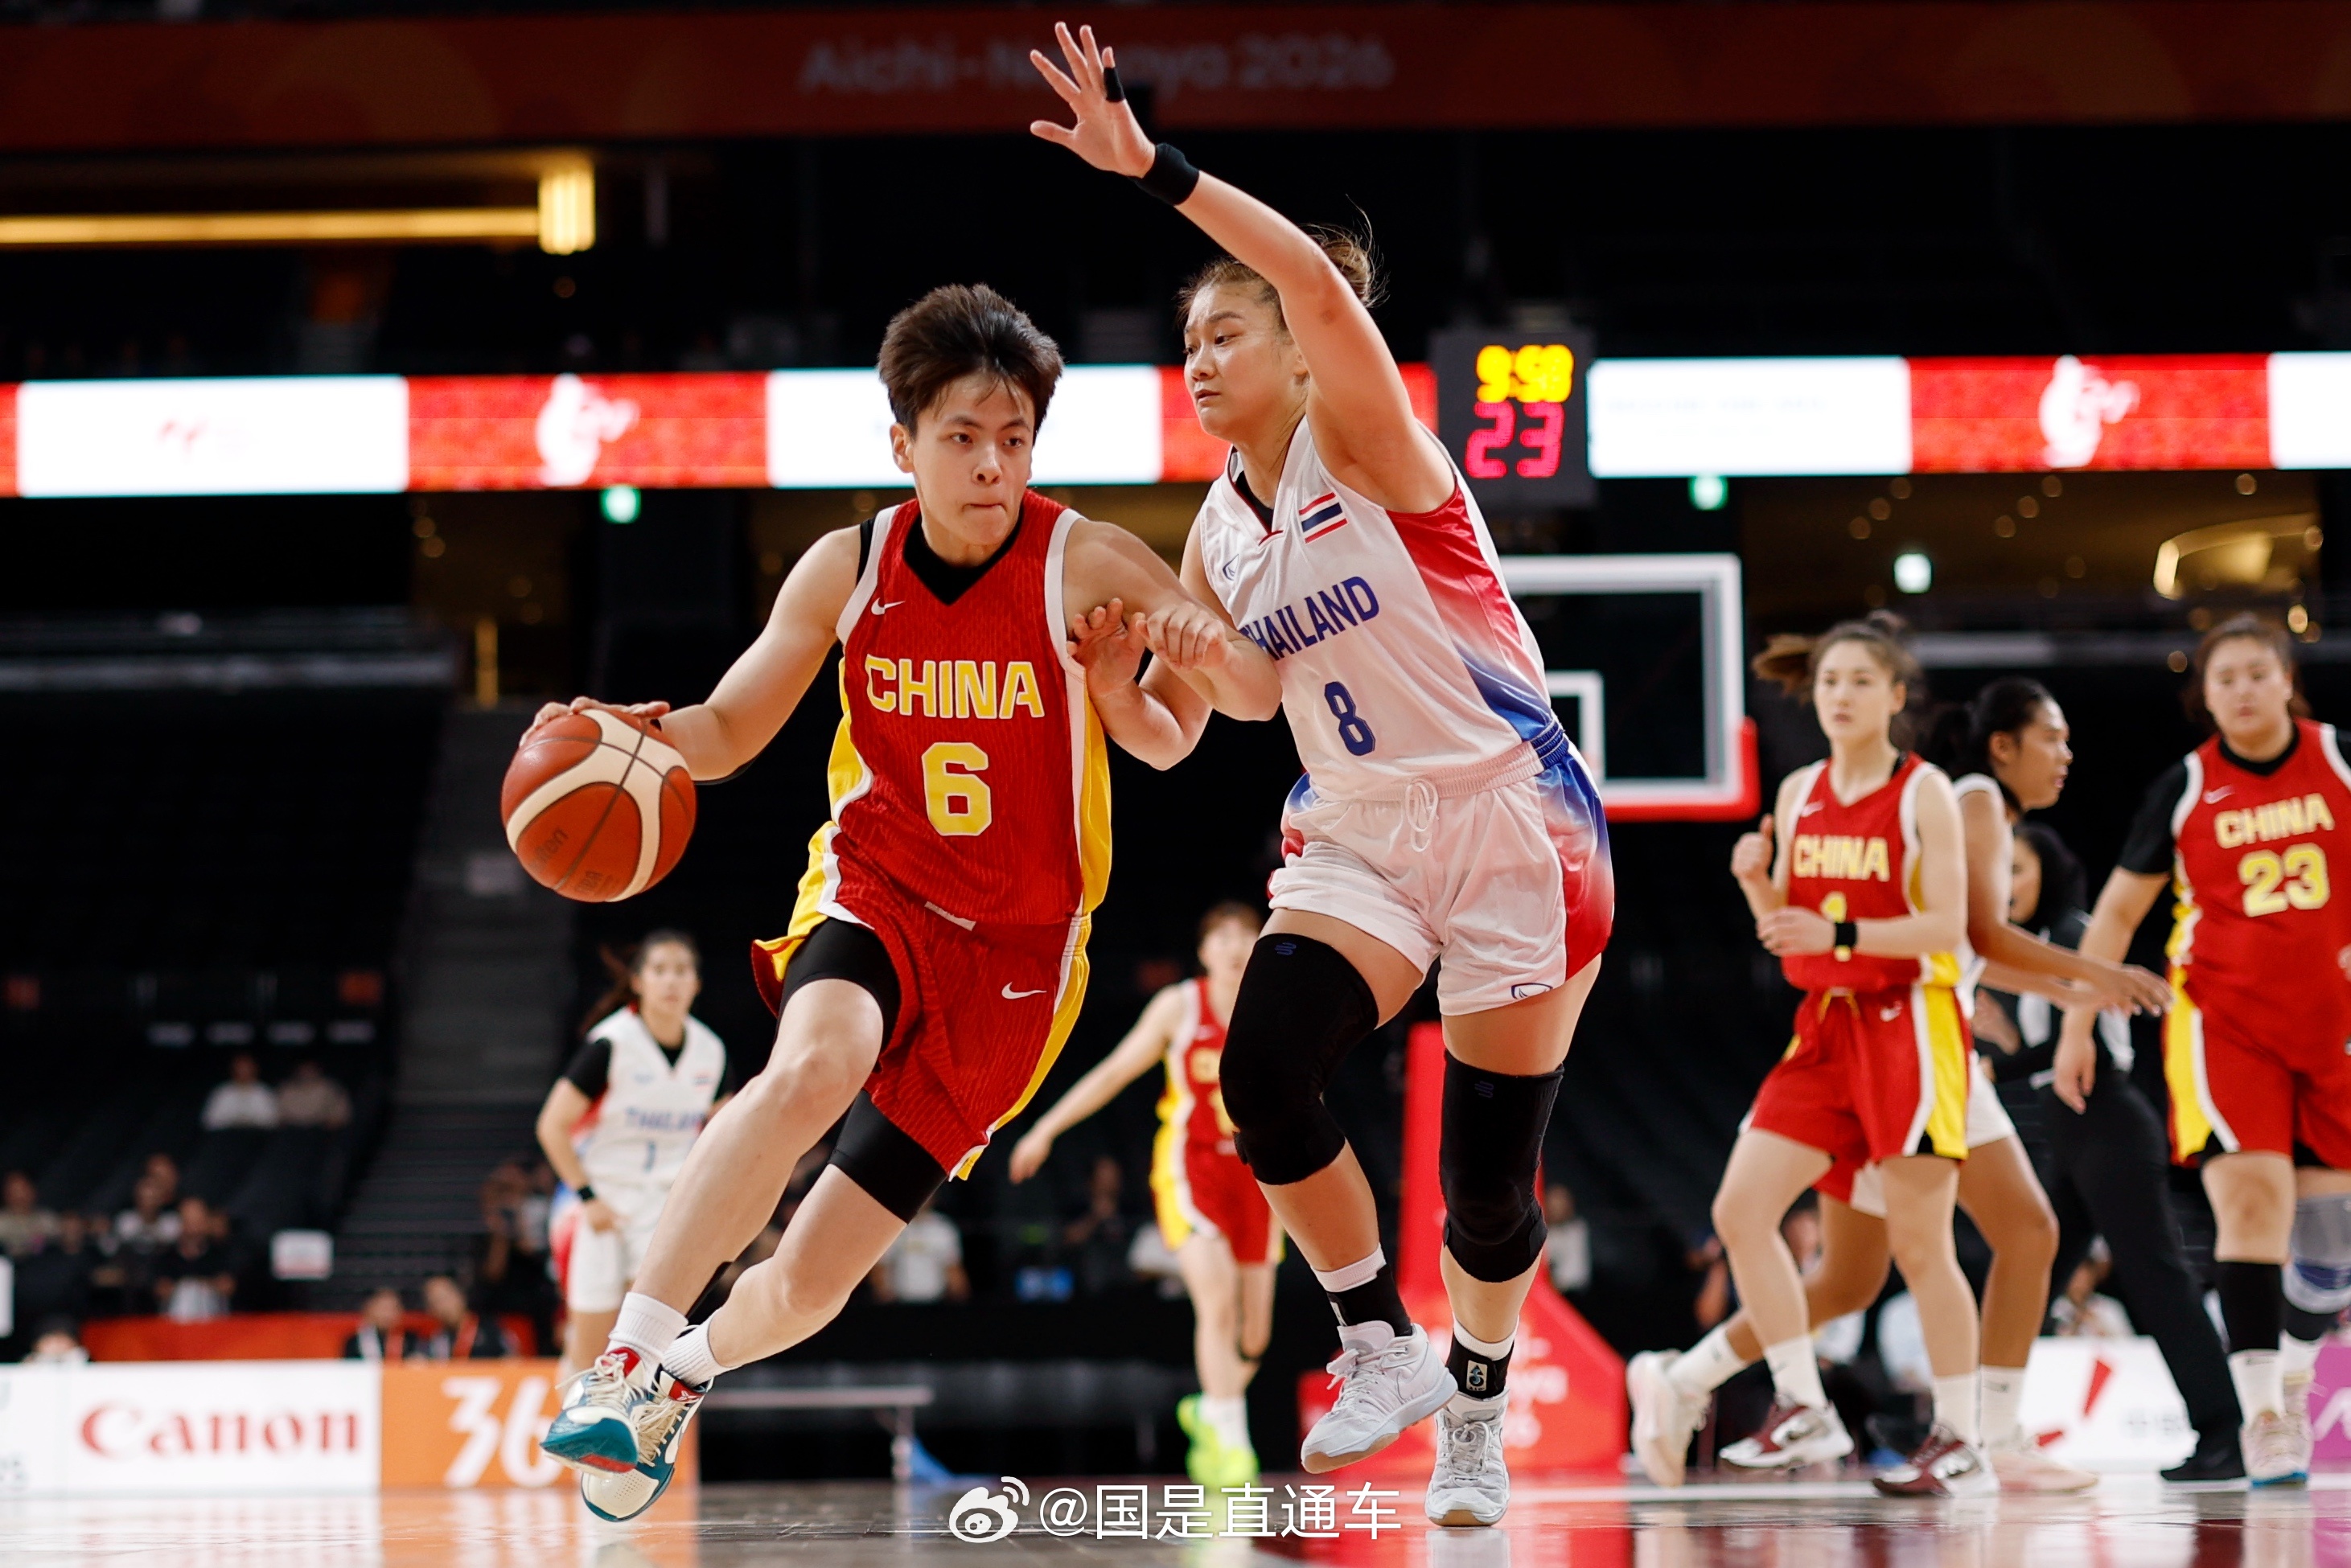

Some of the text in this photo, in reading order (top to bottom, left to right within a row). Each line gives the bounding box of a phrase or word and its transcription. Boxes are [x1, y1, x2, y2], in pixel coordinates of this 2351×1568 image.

[1239, 35, 1392, 88] 2026
[1465, 400, 1566, 479] 23
[865, 654, 1045, 719] CHINA
[1324, 680, 1375, 756] 8
[922, 742, 992, 836] 6
[2214, 792, 2335, 849] CHINA
[1793, 835, 1890, 882] CHINA
[2238, 843, 2331, 917] 23
[643, 1140, 657, 1173] 1
[79, 1399, 361, 1459] Canon
